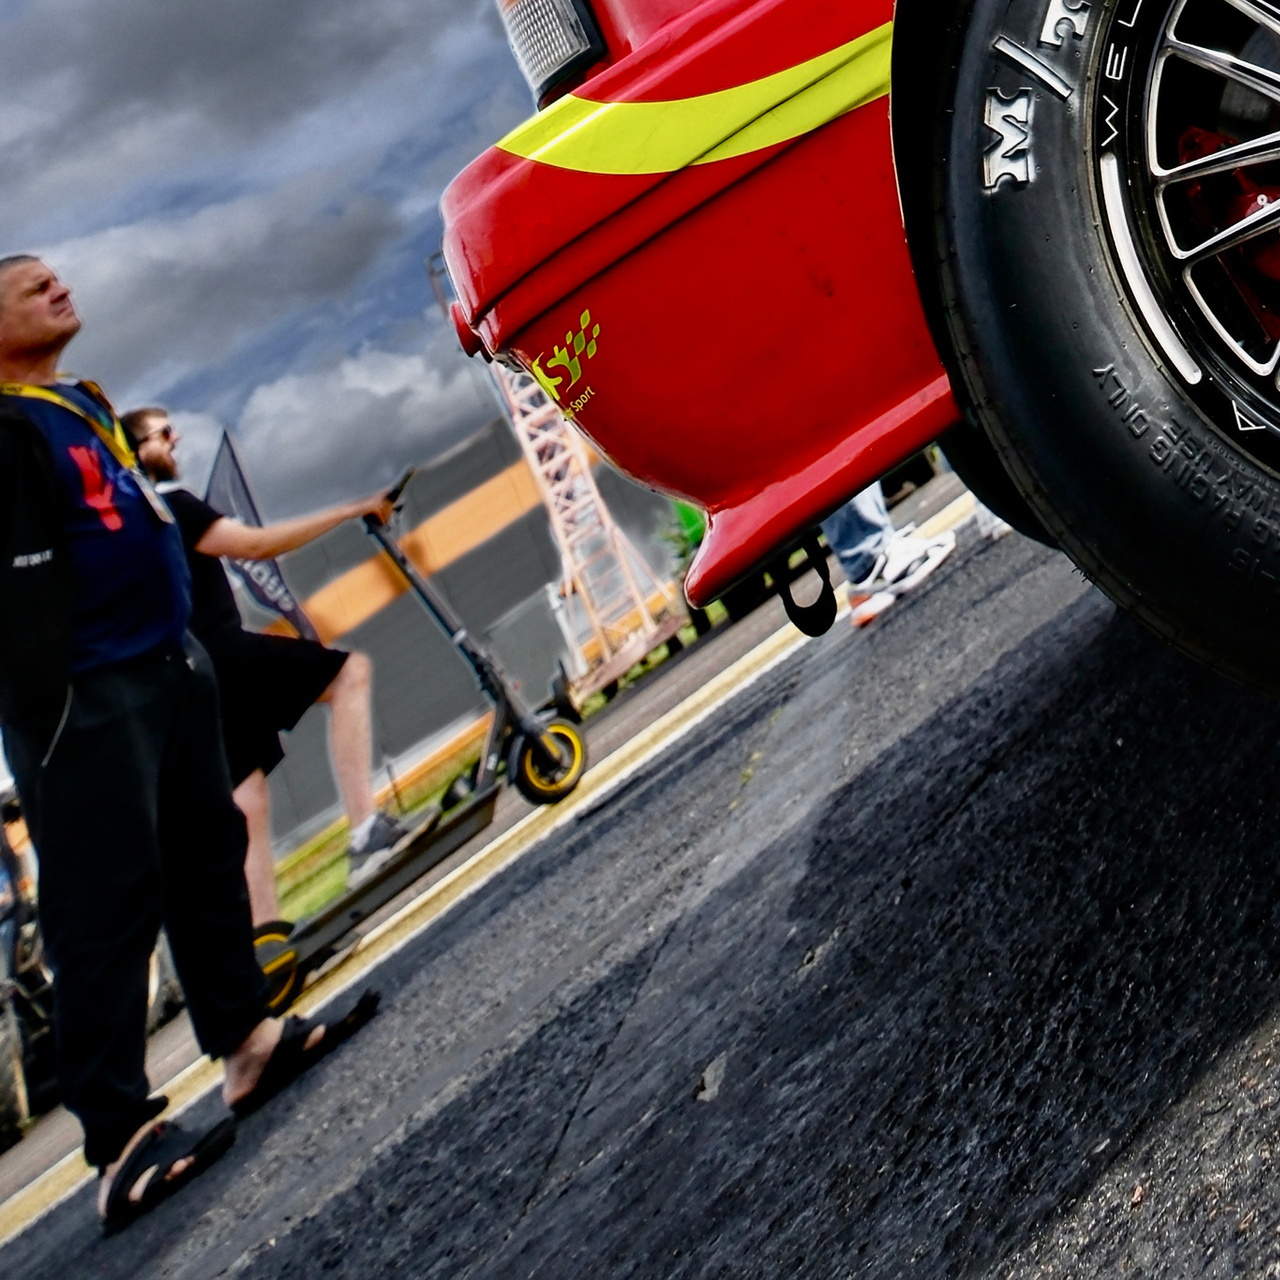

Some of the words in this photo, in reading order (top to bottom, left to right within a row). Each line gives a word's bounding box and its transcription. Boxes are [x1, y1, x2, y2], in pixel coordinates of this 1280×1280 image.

[569, 385, 596, 413] Sport
[1092, 362, 1152, 438] ONLY
[1162, 415, 1215, 475] USE
[1149, 435, 1246, 528] RACING
